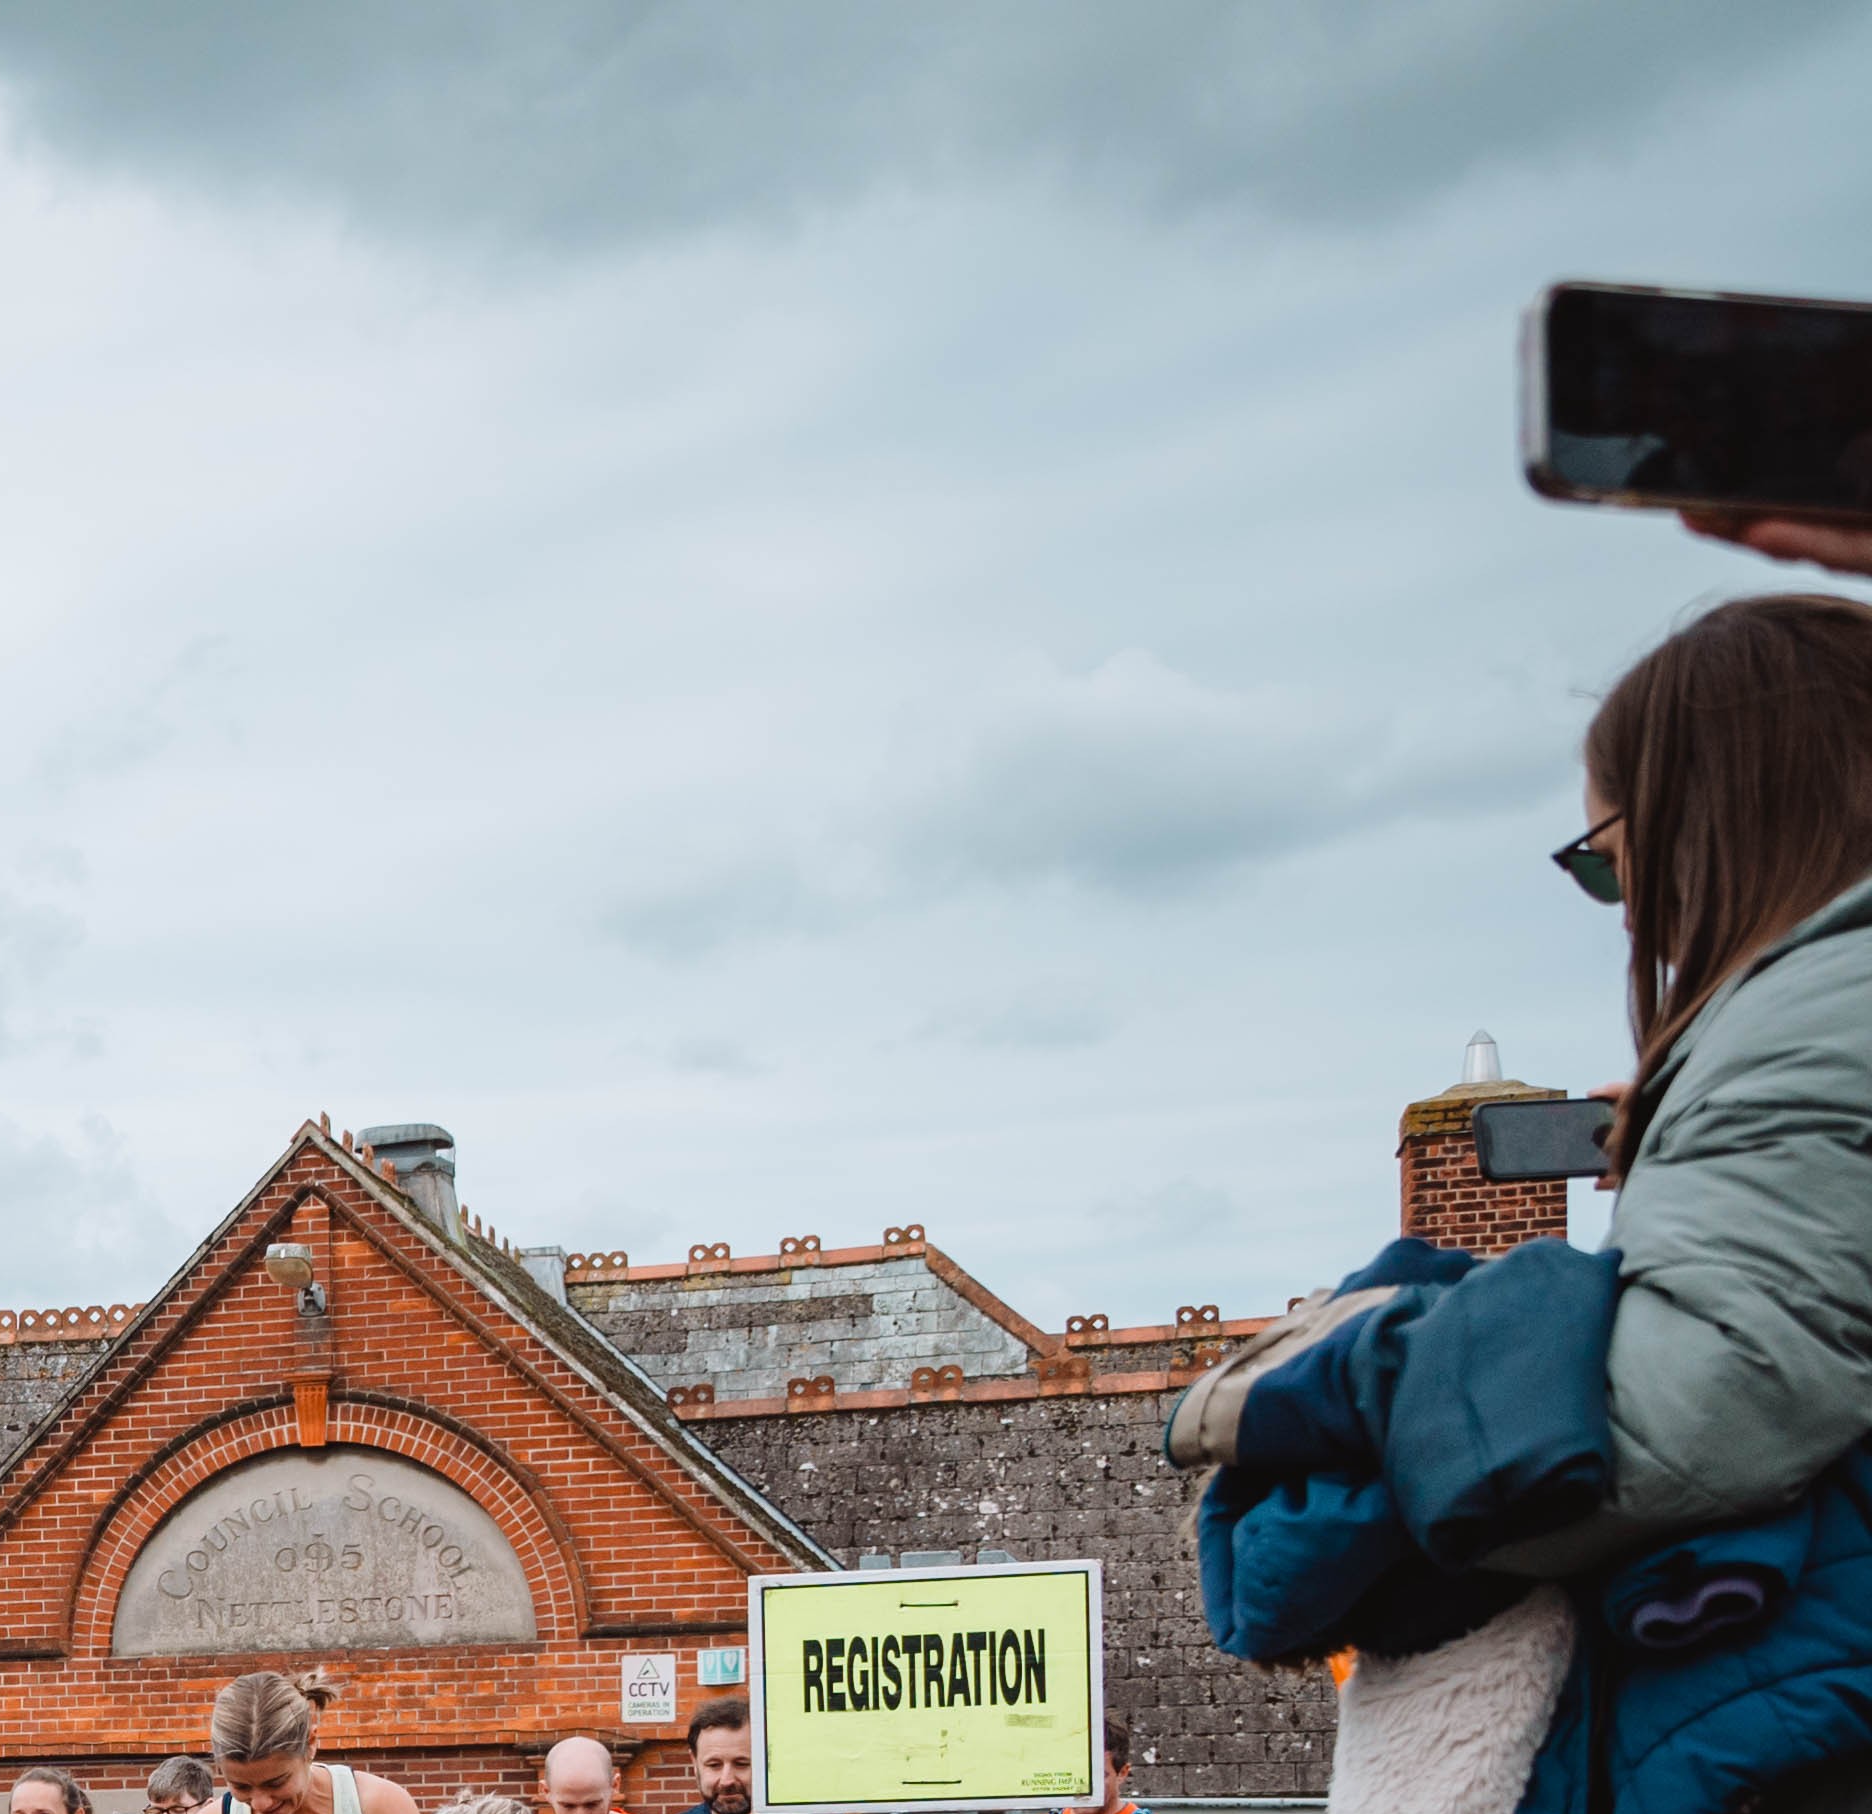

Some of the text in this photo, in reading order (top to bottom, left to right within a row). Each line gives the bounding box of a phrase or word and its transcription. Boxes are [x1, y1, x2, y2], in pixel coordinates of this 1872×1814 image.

[157, 1473, 473, 1599] COUNCIL SCHOOL
[628, 1681, 670, 1698] CCTV
[802, 1628, 1046, 1713] REGISTRATION
